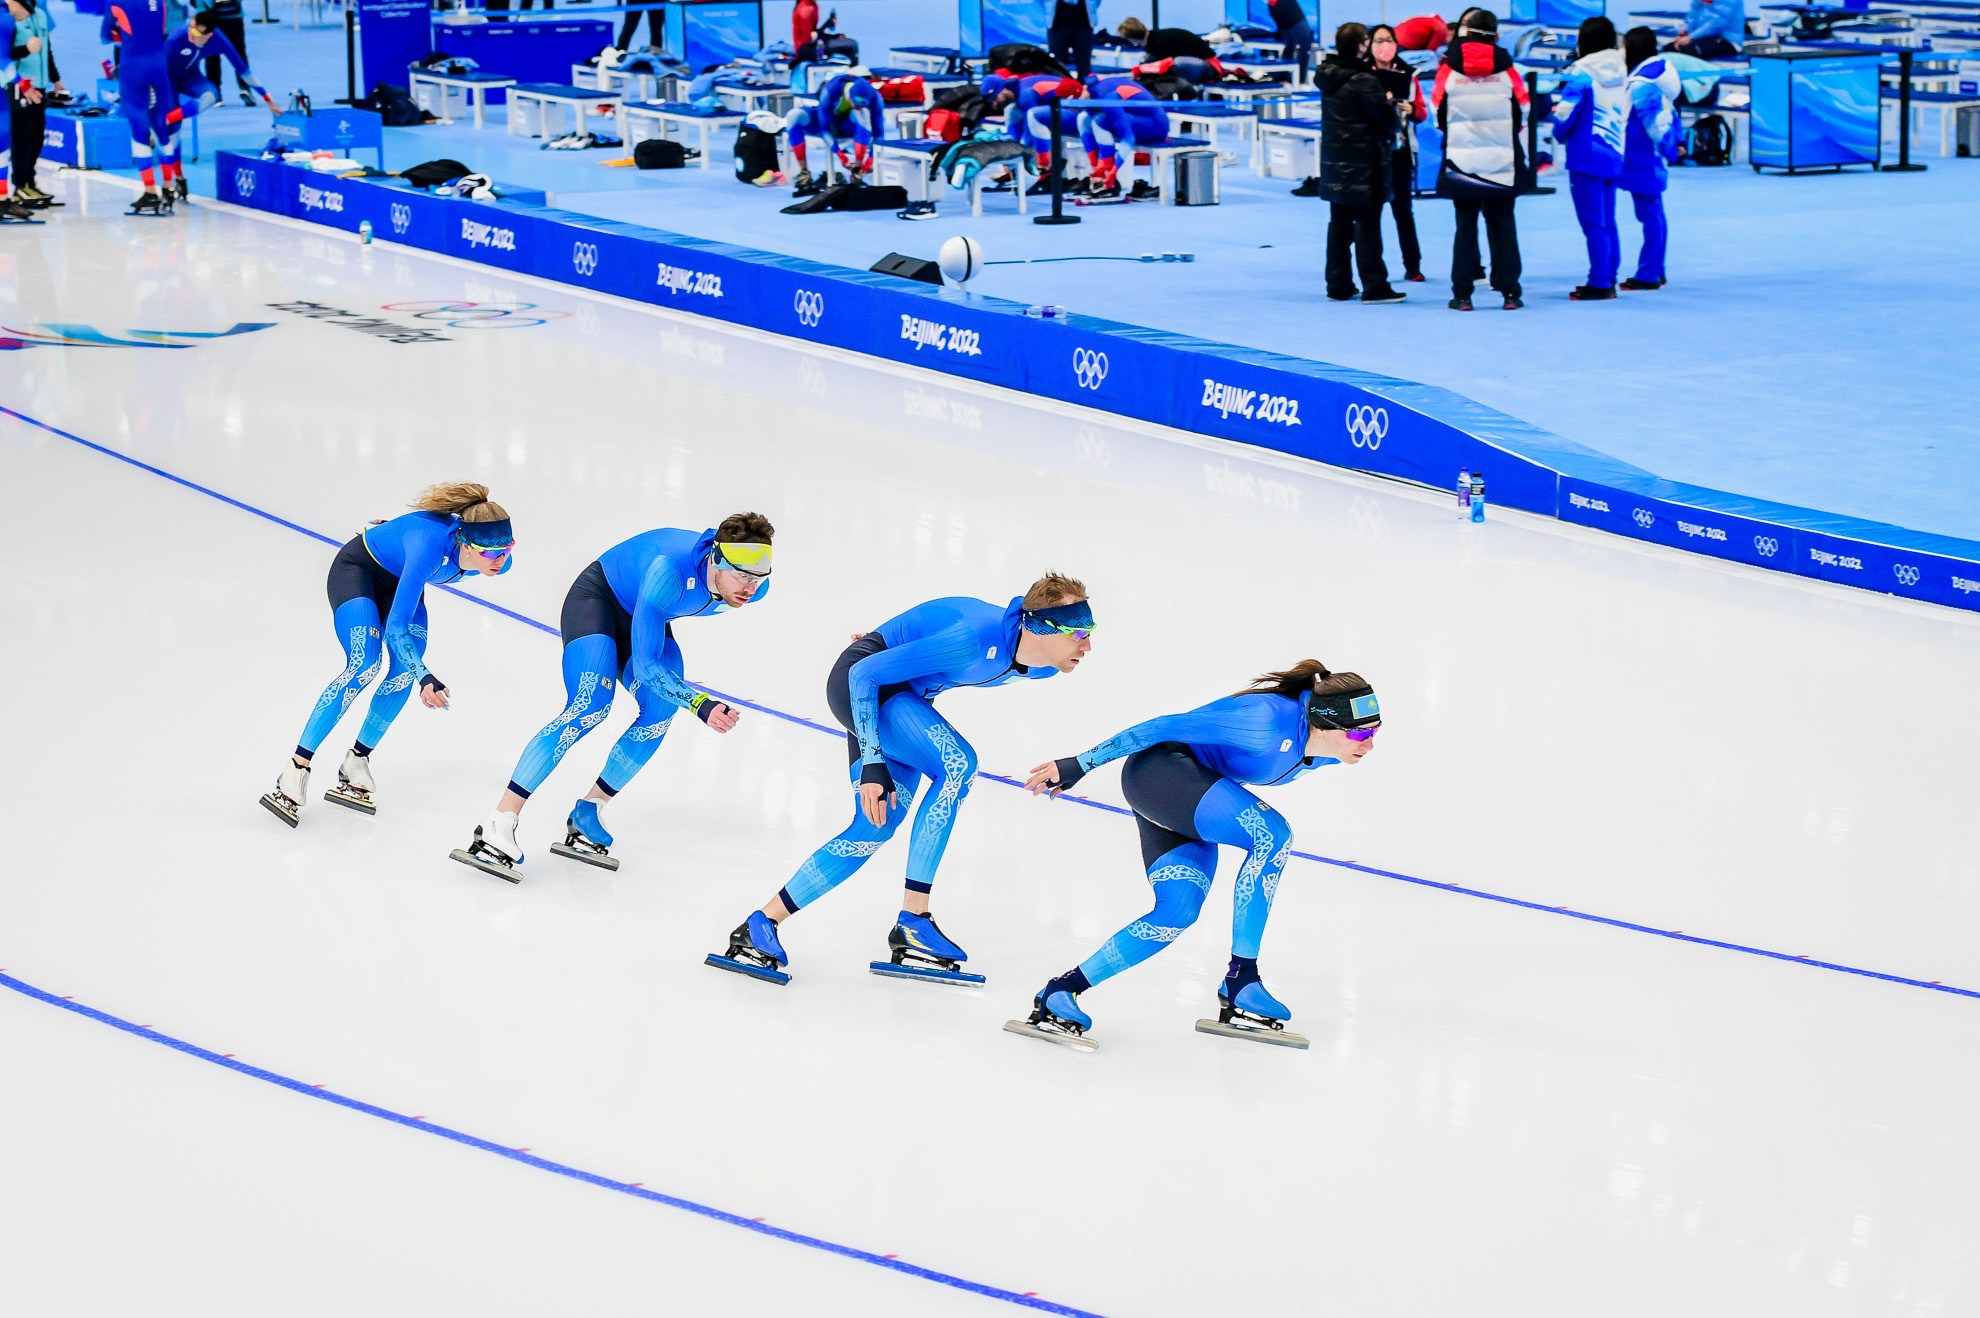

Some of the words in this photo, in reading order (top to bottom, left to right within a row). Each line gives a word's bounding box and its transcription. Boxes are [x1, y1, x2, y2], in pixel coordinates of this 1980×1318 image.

[299, 183, 324, 211] BEIJING
[324, 191, 344, 212] 2022
[461, 218, 491, 248] BEIJING
[490, 226, 516, 251] 2022
[657, 262, 694, 295] BEIJING
[693, 271, 724, 298] 2022
[900, 313, 947, 351] BEIJING
[947, 326, 982, 357] 2022
[1201, 378, 1257, 420] BEIJING
[1255, 393, 1302, 427] 2022
[1569, 492, 1591, 509] BEIJING
[1590, 498, 1611, 513] 2022
[1676, 520, 1705, 537] BEIJING
[1705, 527, 1728, 541] 2022
[1810, 548, 1838, 566] BEIJING
[1838, 555, 1864, 570] 2022
[1951, 576, 1980, 594] BEIJIN
